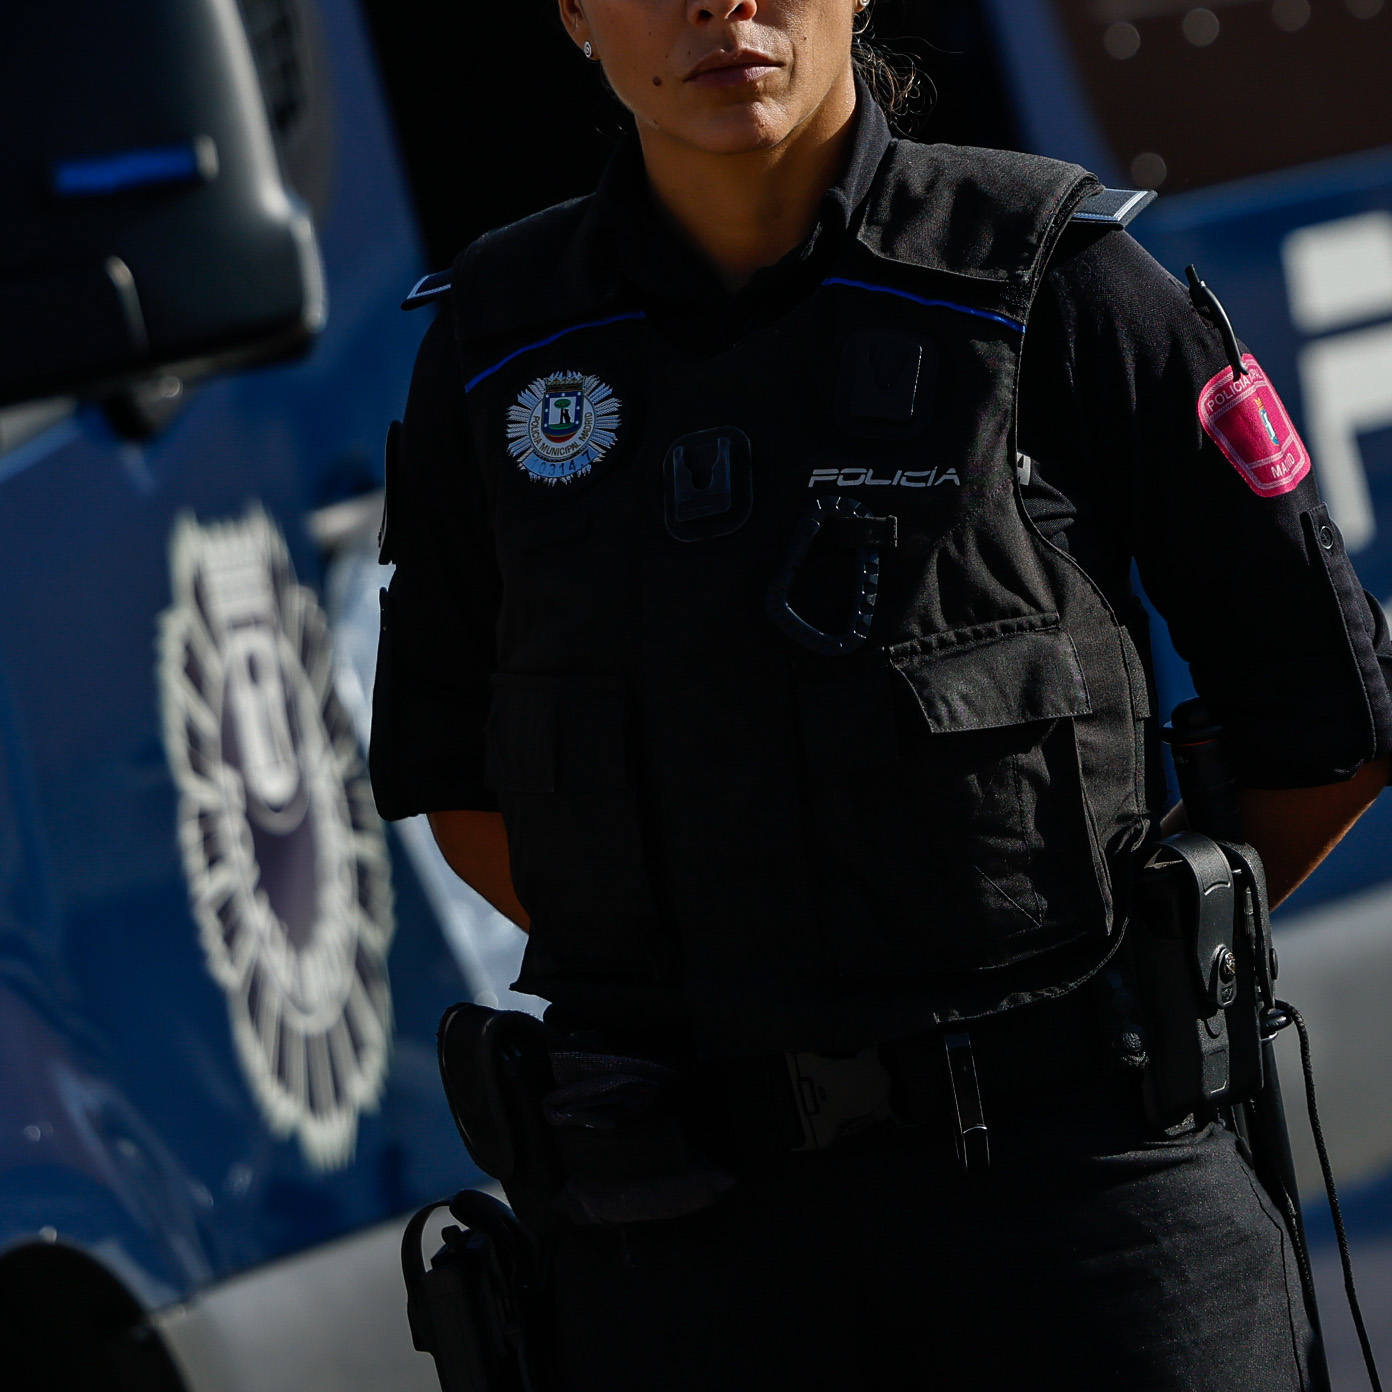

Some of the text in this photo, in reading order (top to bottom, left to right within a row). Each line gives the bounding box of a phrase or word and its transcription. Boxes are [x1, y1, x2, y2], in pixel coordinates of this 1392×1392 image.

[1207, 375, 1251, 412] POLICIA
[531, 412, 592, 457] POLICIA MUNICIPAL MADRID
